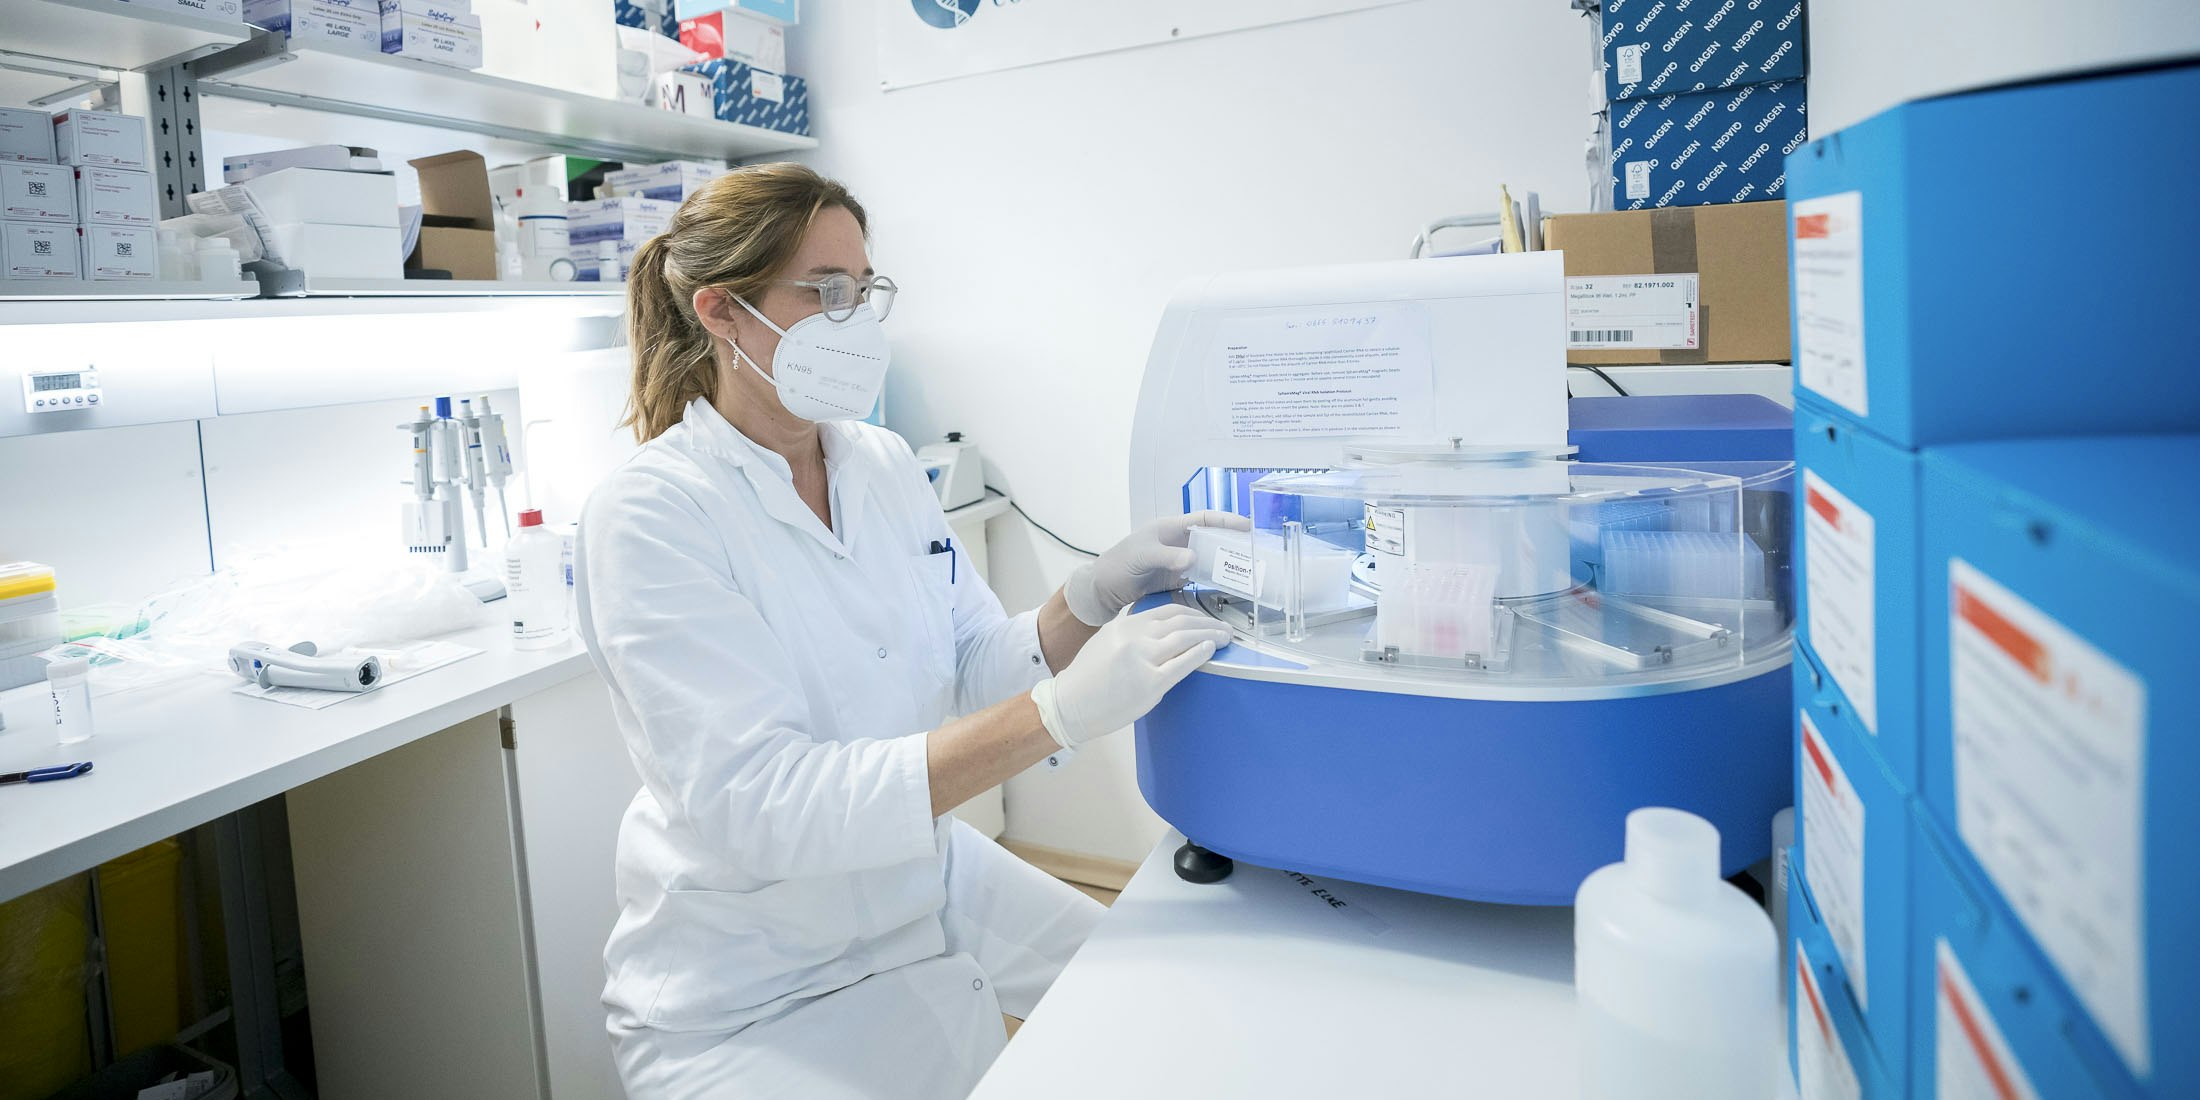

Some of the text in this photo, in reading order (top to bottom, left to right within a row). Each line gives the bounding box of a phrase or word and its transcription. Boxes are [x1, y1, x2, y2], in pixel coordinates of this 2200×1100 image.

[178, 0, 206, 9] SMALL
[1636, 1, 1666, 32] QIAGEN
[1704, 0, 1735, 32] QIAGEN
[327, 30, 350, 38] LARGE
[1662, 20, 1694, 52] QIAGEN
[1732, 20, 1764, 52] QIAGEN
[1690, 40, 1721, 72] QIAGEN
[1760, 40, 1793, 73] QIAGEN
[1648, 61, 1678, 93] QIAGEN
[1618, 98, 1648, 129] QIAGEN
[1684, 101, 1715, 131] QIAGEN
[1754, 102, 1787, 134] QIAGEN
[1644, 119, 1674, 149] QIAGEN
[1711, 121, 1742, 152] QIAGEN
[1670, 139, 1701, 170] QIAGEN
[1738, 143, 1770, 174] QIAGEN
[1697, 160, 1728, 192] QIAGEN
[1655, 179, 1685, 208] QIAGEN
[1634, 281, 1675, 289] 82.1971.002
[786, 361, 813, 375] KN95
